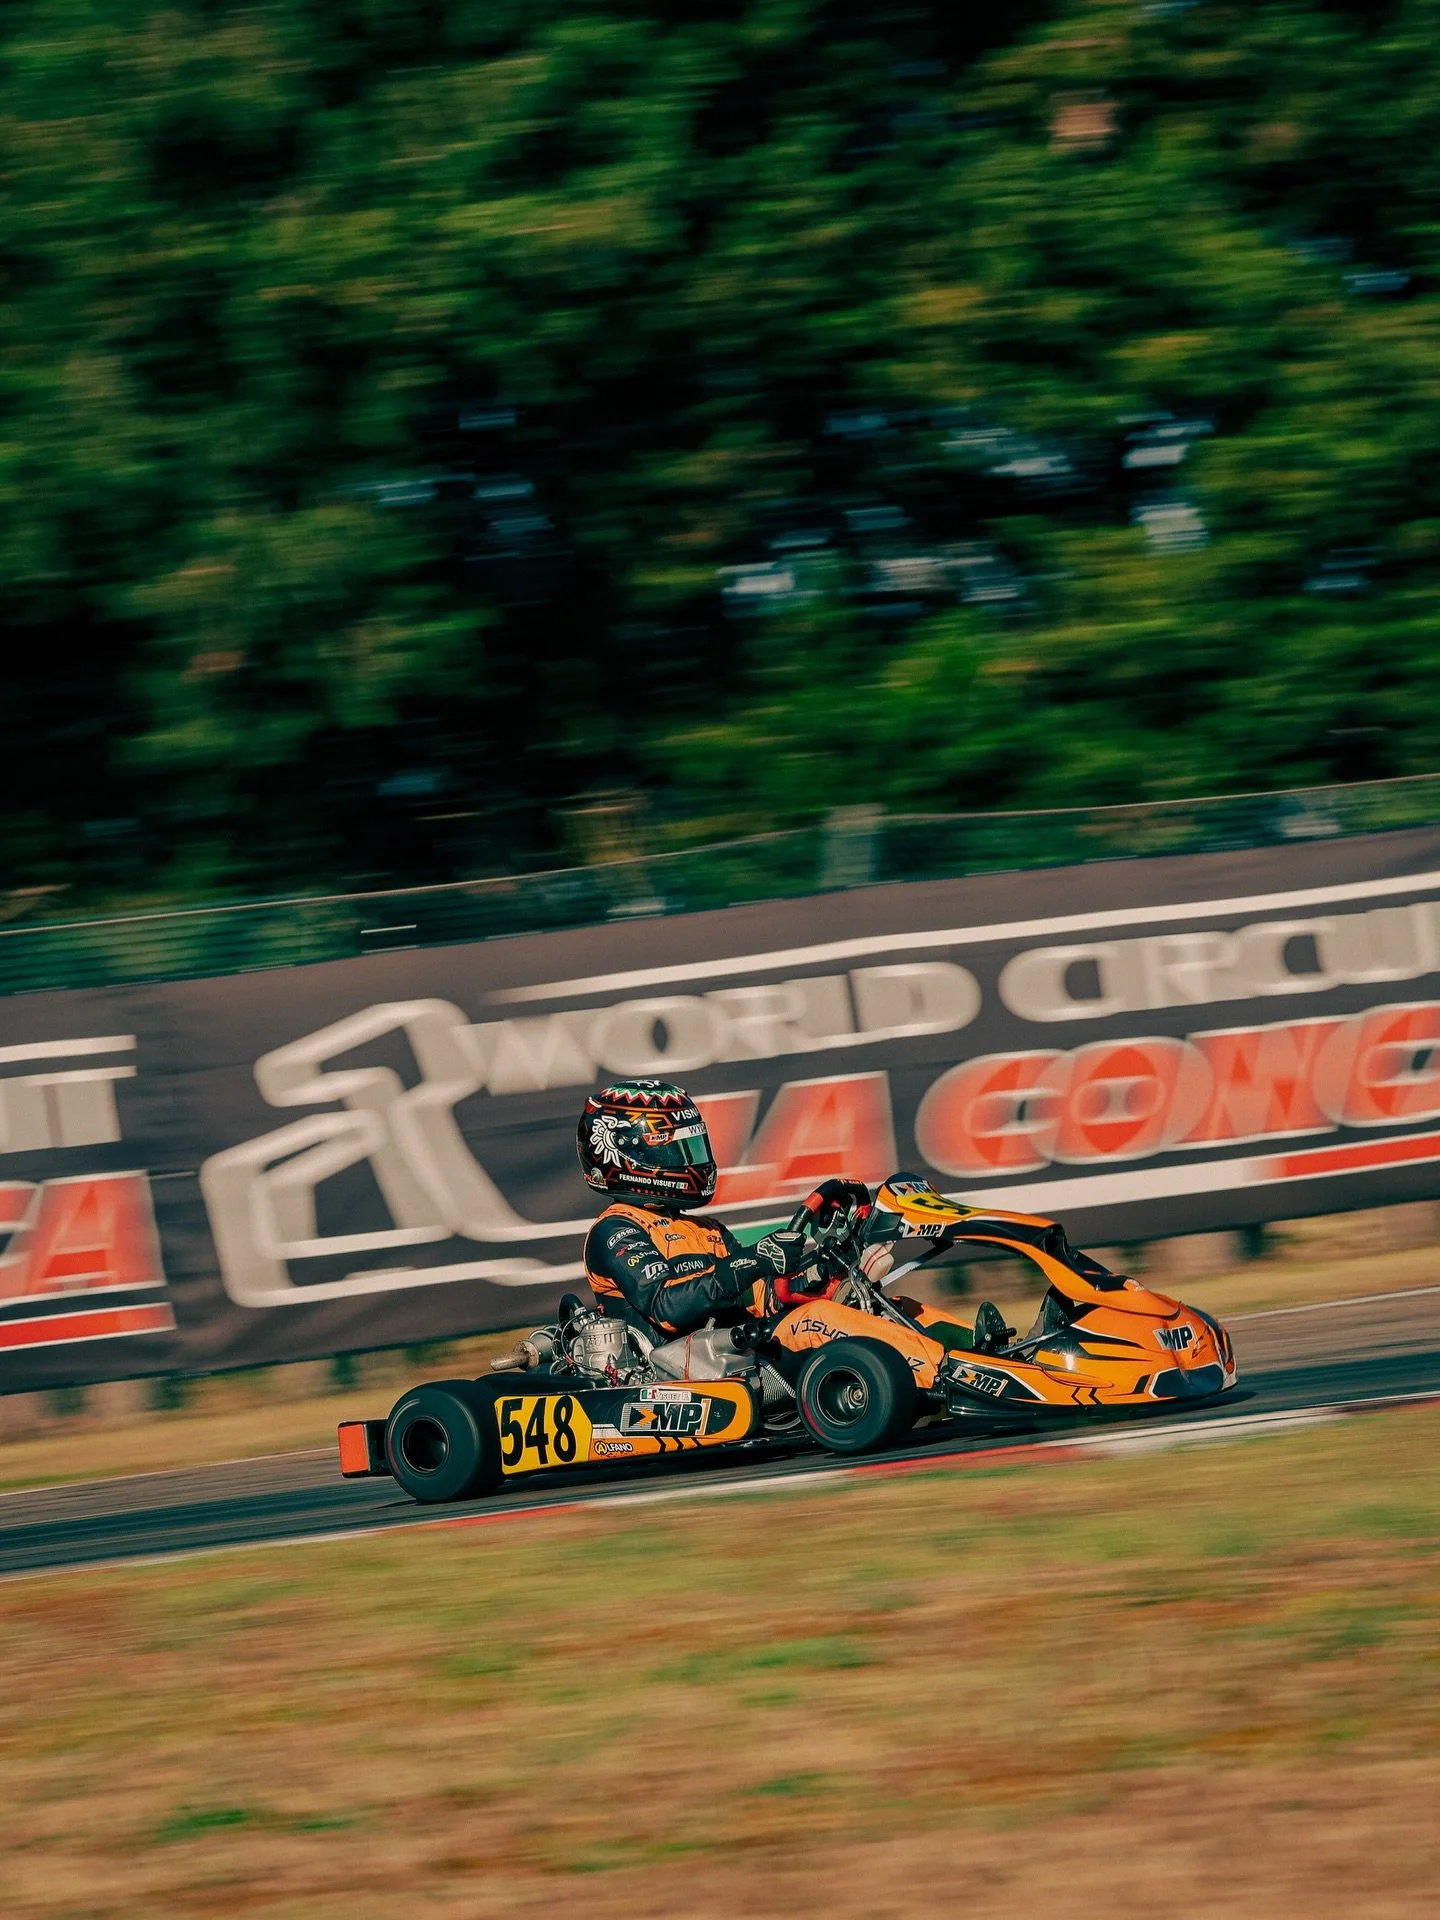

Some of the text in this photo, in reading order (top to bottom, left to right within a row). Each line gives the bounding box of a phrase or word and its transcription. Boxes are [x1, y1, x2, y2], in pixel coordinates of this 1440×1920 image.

[915, 1000, 1440, 1178] CONC
[619, 1173, 652, 1185] FERNANDO
[653, 1178, 676, 1189] VISUET
[674, 1260, 704, 1274] VISNAV
[501, 1395, 577, 1466] 548
[594, 1441, 633, 1455] ALFANO
